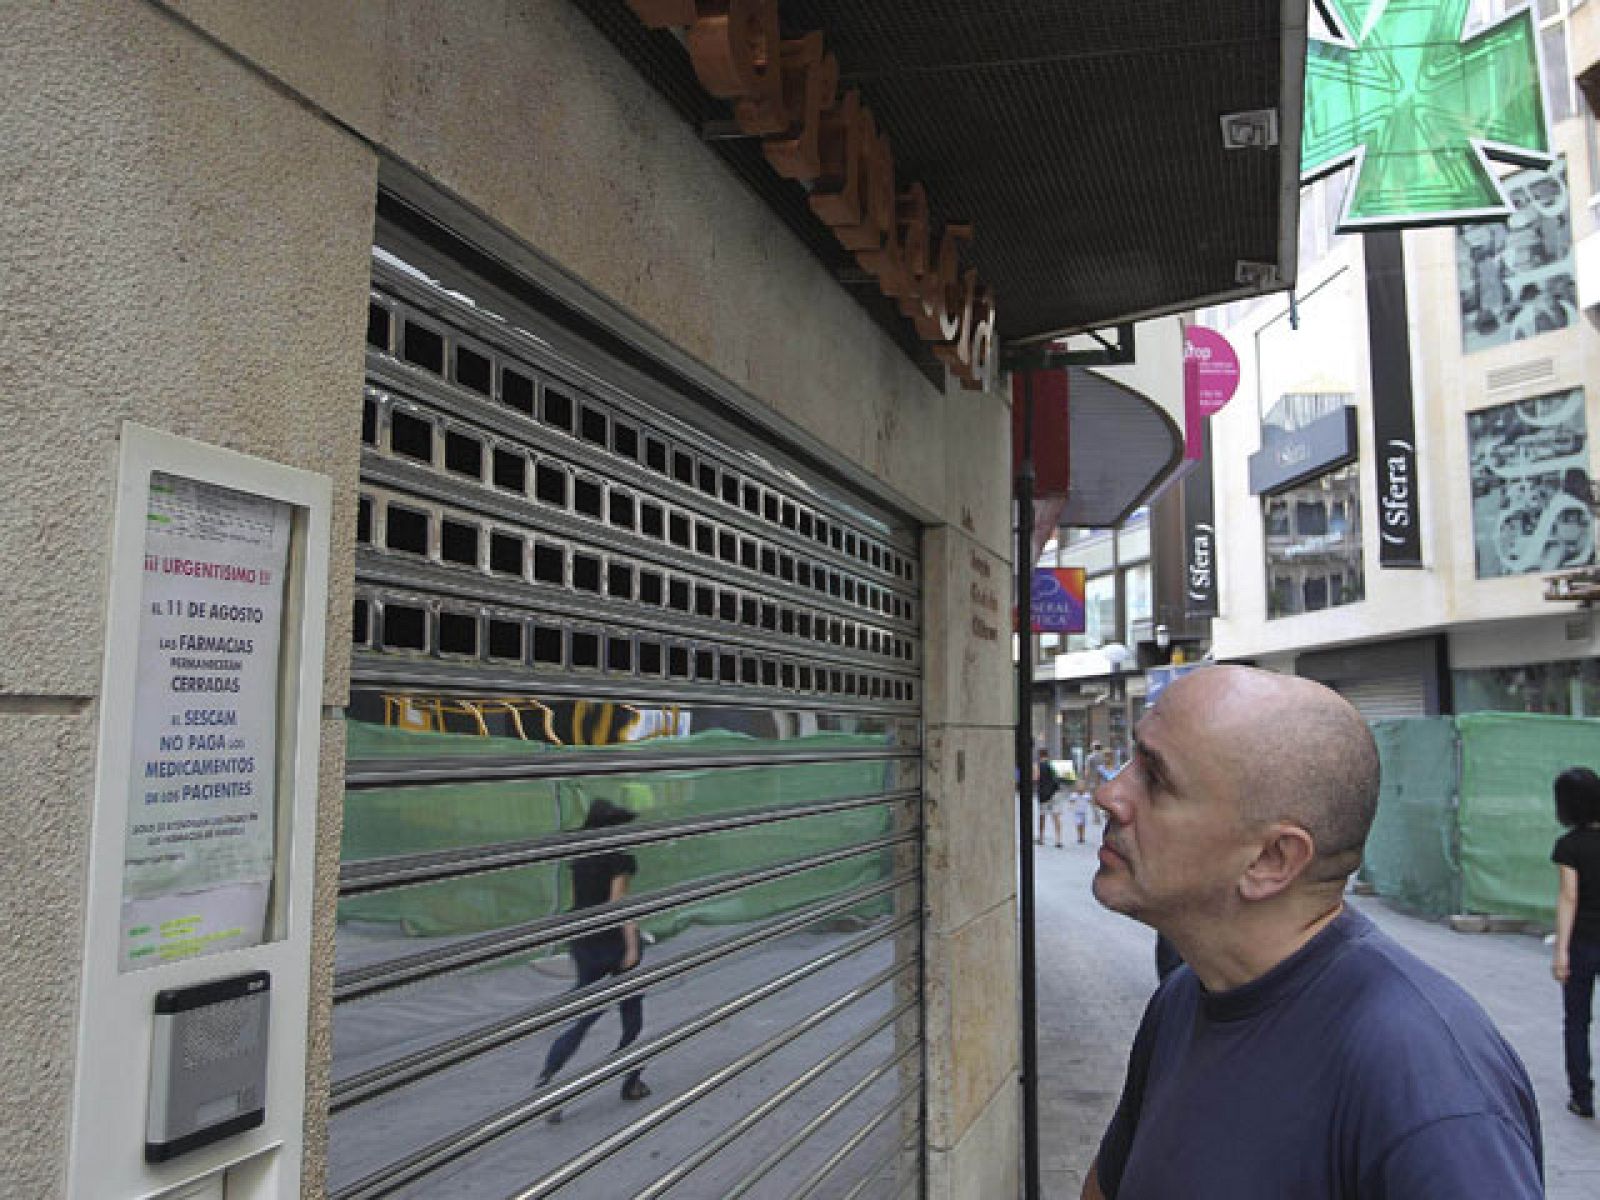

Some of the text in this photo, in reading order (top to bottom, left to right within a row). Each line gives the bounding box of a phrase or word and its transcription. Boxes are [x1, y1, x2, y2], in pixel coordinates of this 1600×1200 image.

[167, 599, 181, 616] 11
[188, 602, 206, 618] DE
[209, 604, 264, 624] AGOSTO
[179, 634, 254, 655] FARMACIAS
[171, 675, 241, 693] CERRADAS
[184, 709, 238, 726] SESCAM
[159, 735, 184, 751] NO
[188, 734, 226, 751] PAGA
[144, 756, 256, 778] MEDICAMENTOS
[182, 781, 252, 801] PACIENTES
